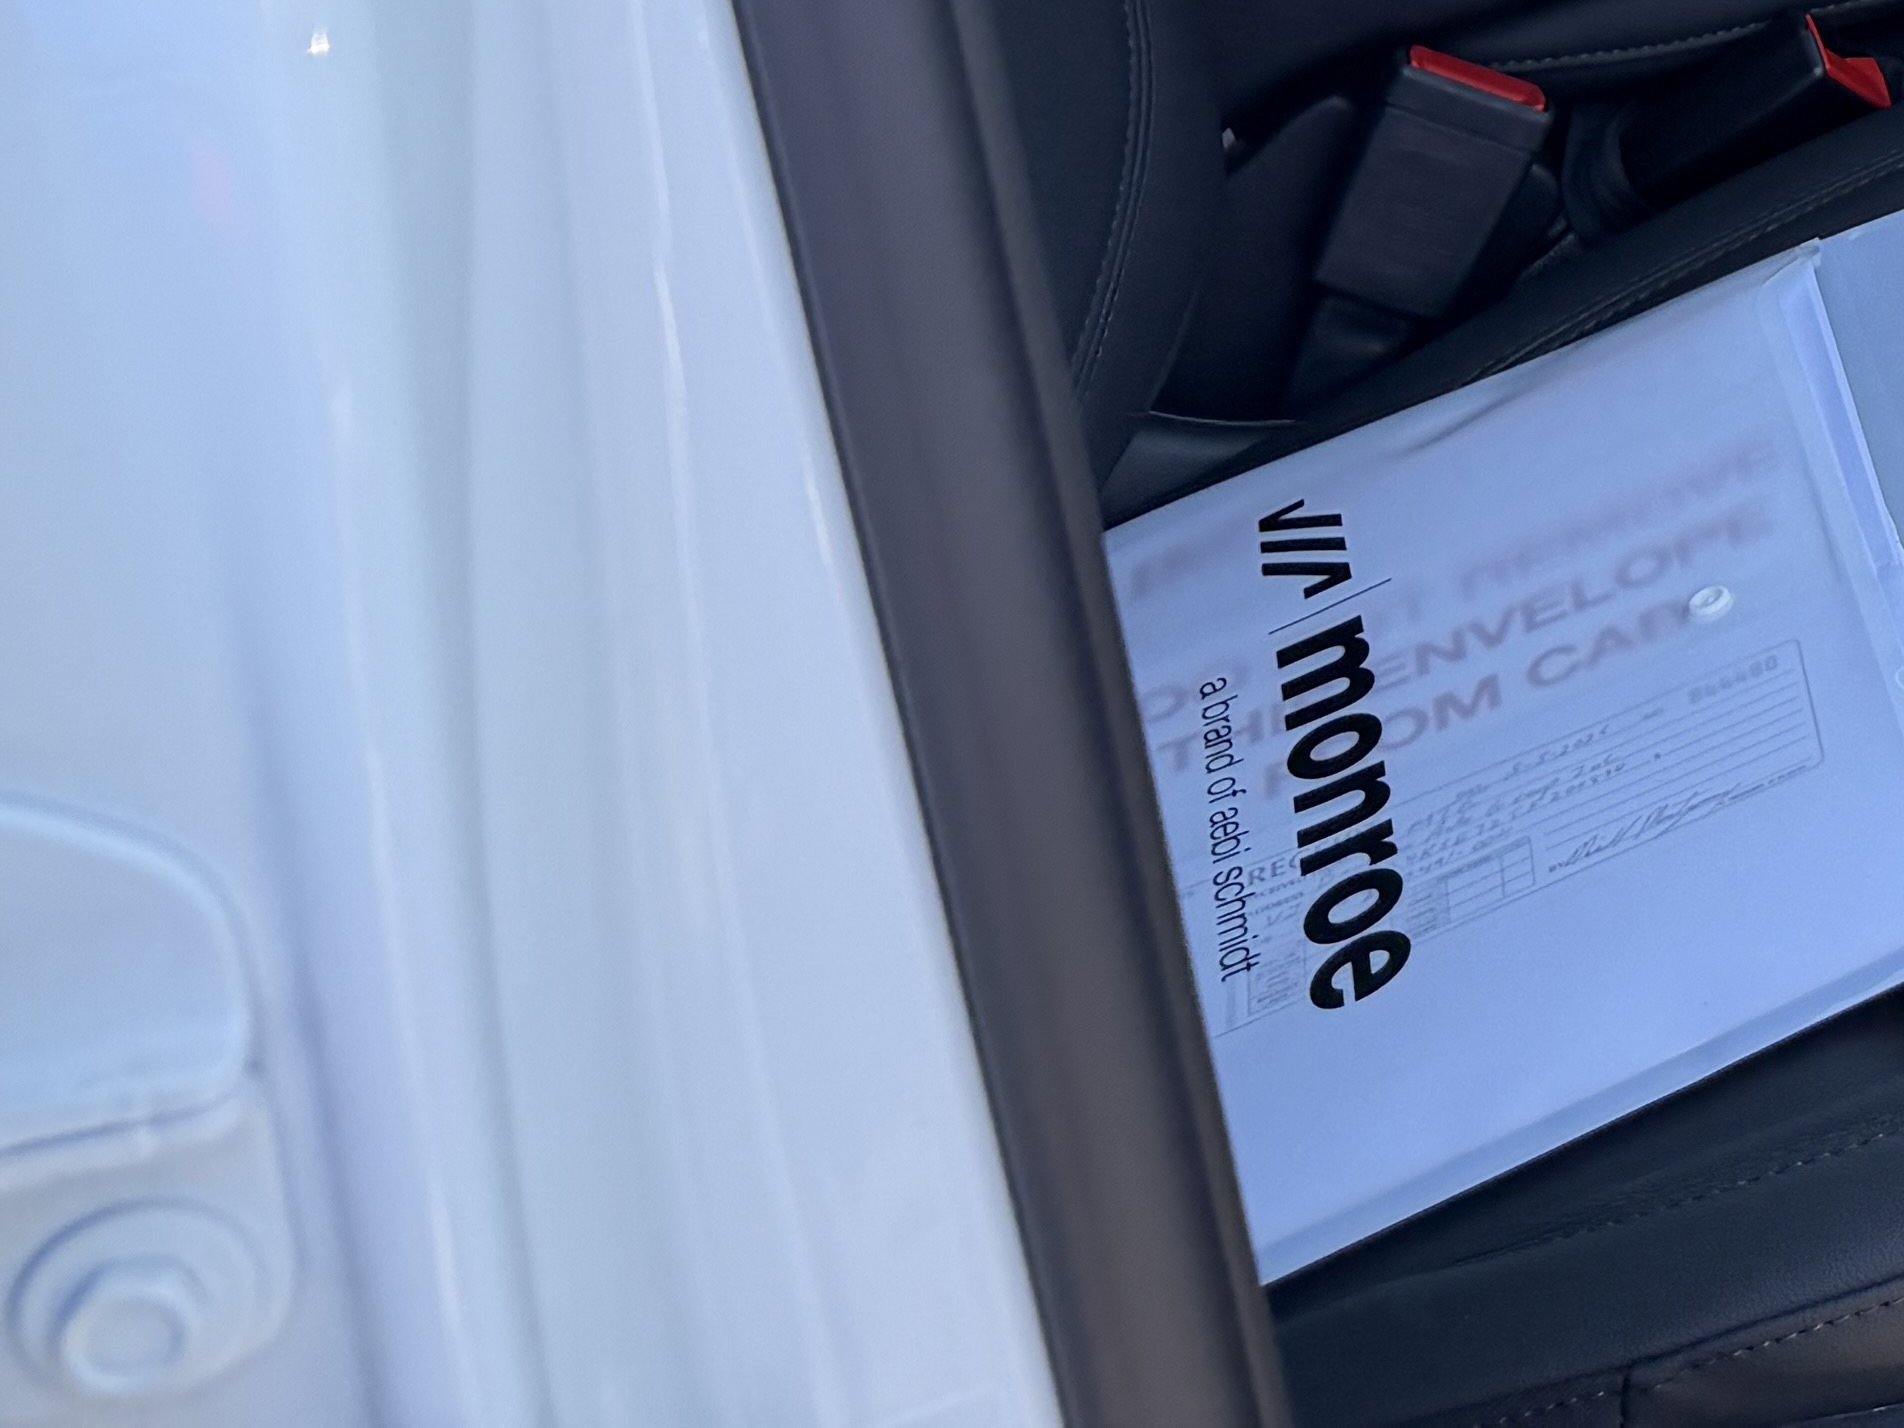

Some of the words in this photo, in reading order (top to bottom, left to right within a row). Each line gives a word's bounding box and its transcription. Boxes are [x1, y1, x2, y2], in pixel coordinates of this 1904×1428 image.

[1368, 496, 1776, 694] ENVELOPE
[1199, 676, 1228, 700] a
[1201, 694, 1244, 774] brand
[1262, 671, 1503, 802] FOM
[1206, 772, 1247, 804] of
[1208, 805, 1251, 864] aebi
[1276, 614, 1412, 1010] monroe
[1212, 864, 1261, 982] schmidt
